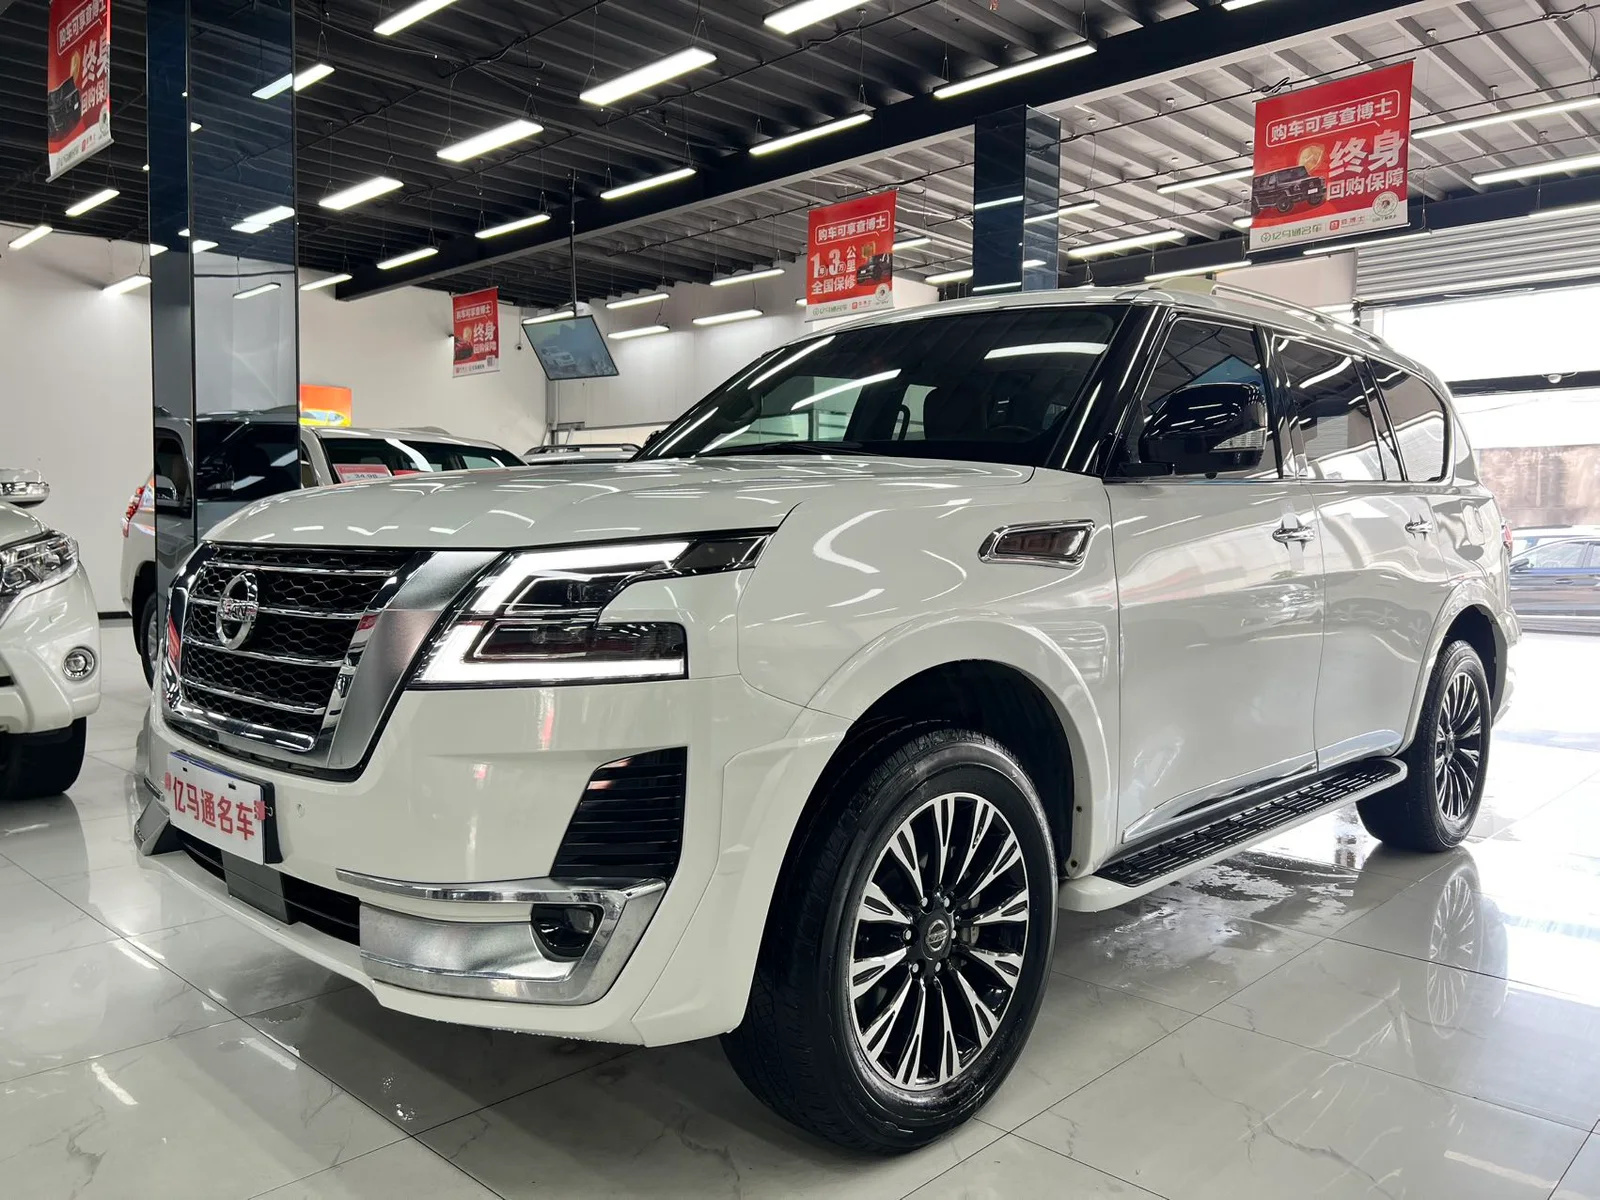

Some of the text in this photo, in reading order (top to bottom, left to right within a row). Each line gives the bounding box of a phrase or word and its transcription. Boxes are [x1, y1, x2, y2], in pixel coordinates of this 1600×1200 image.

[81, 29, 110, 88] 终身
[1271, 97, 1393, 142] 购车可享查博士
[1328, 129, 1406, 177] 终身
[1327, 167, 1405, 200] 回购保障
[818, 217, 886, 242] 购车可享查博士
[811, 274, 857, 295] 全国保修
[474, 320, 496, 342] 终身
[172, 776, 255, 841] 亿马通名车
